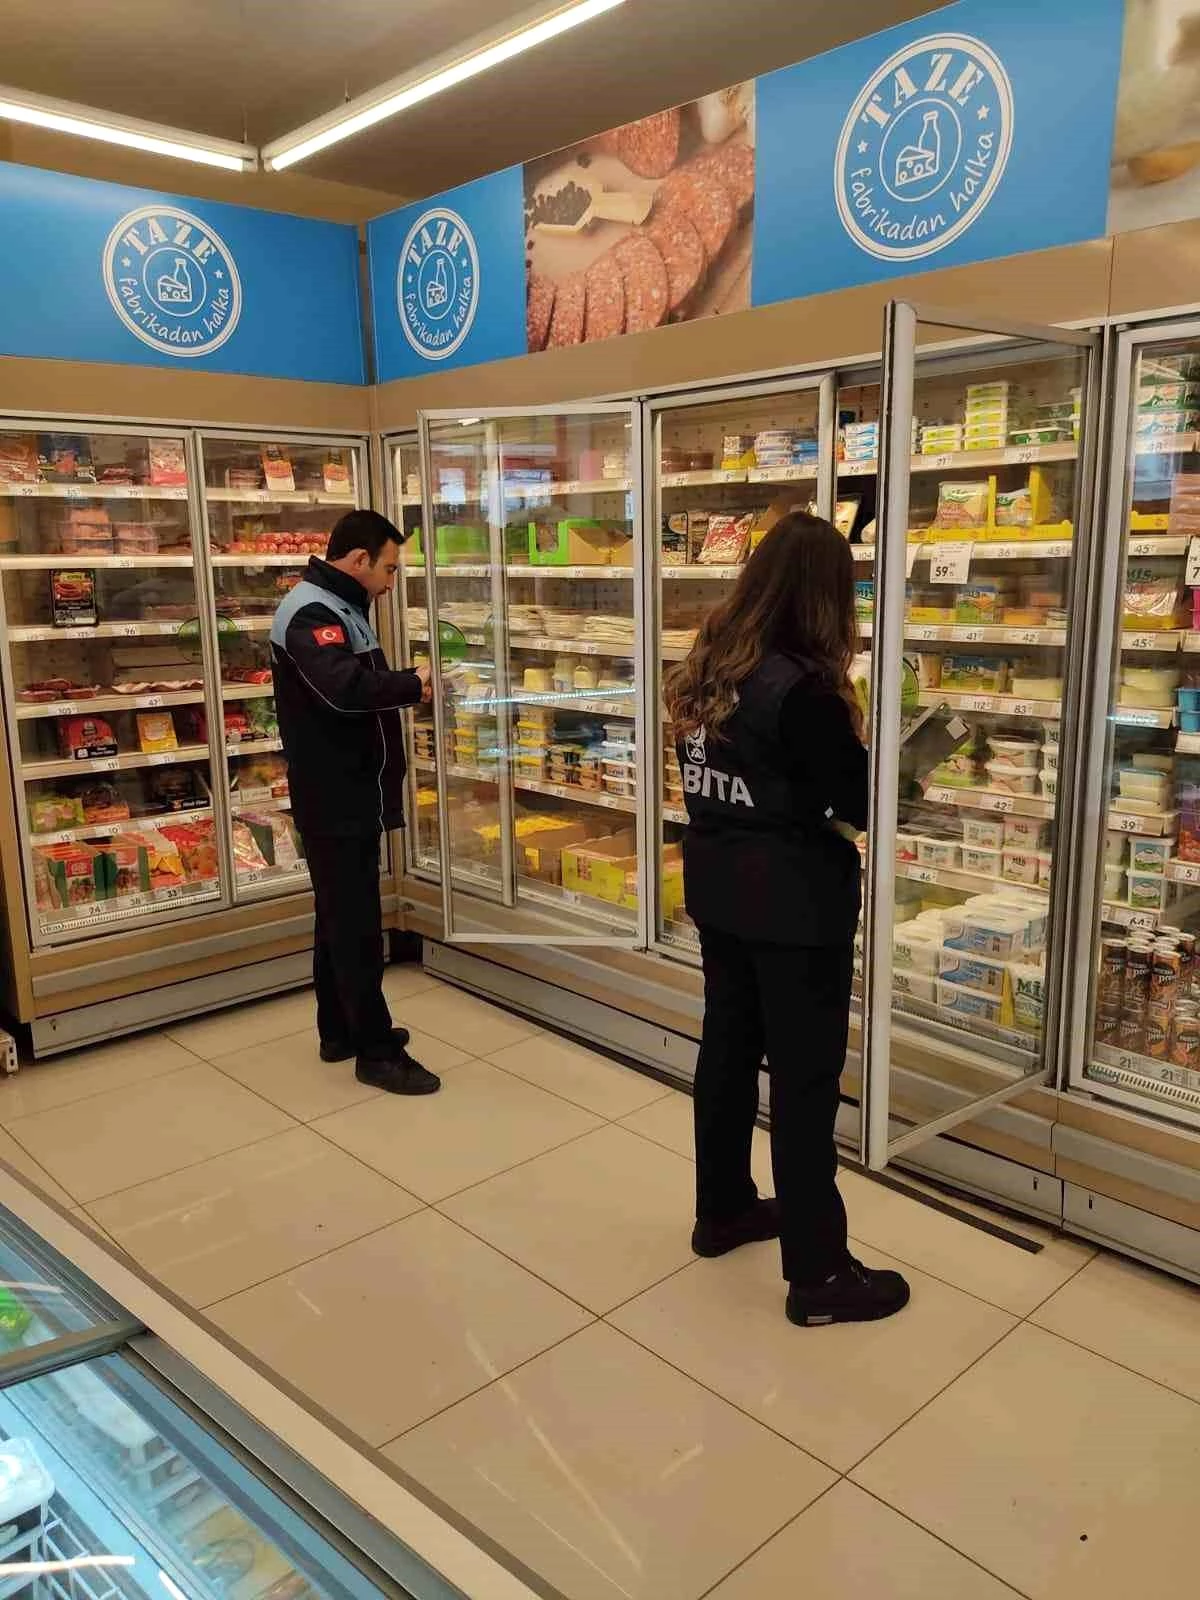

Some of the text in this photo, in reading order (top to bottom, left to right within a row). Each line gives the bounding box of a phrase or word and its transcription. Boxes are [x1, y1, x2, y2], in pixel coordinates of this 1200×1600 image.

[861, 54, 984, 128] TAZE
[851, 131, 994, 241] fabrikadan halka
[122, 216, 216, 264] TAZE
[407, 221, 464, 268] TAZE
[119, 278, 229, 343] fabrikadan halka
[404, 275, 472, 346] fabrikadan halka
[936, 566, 949, 577] 59
[684, 763, 755, 807] BITA
[1120, 819, 1136, 830] 39
[167, 889, 178, 898] 33
[1119, 1056, 1131, 1069] 21
[1161, 1068, 1174, 1081] 21
